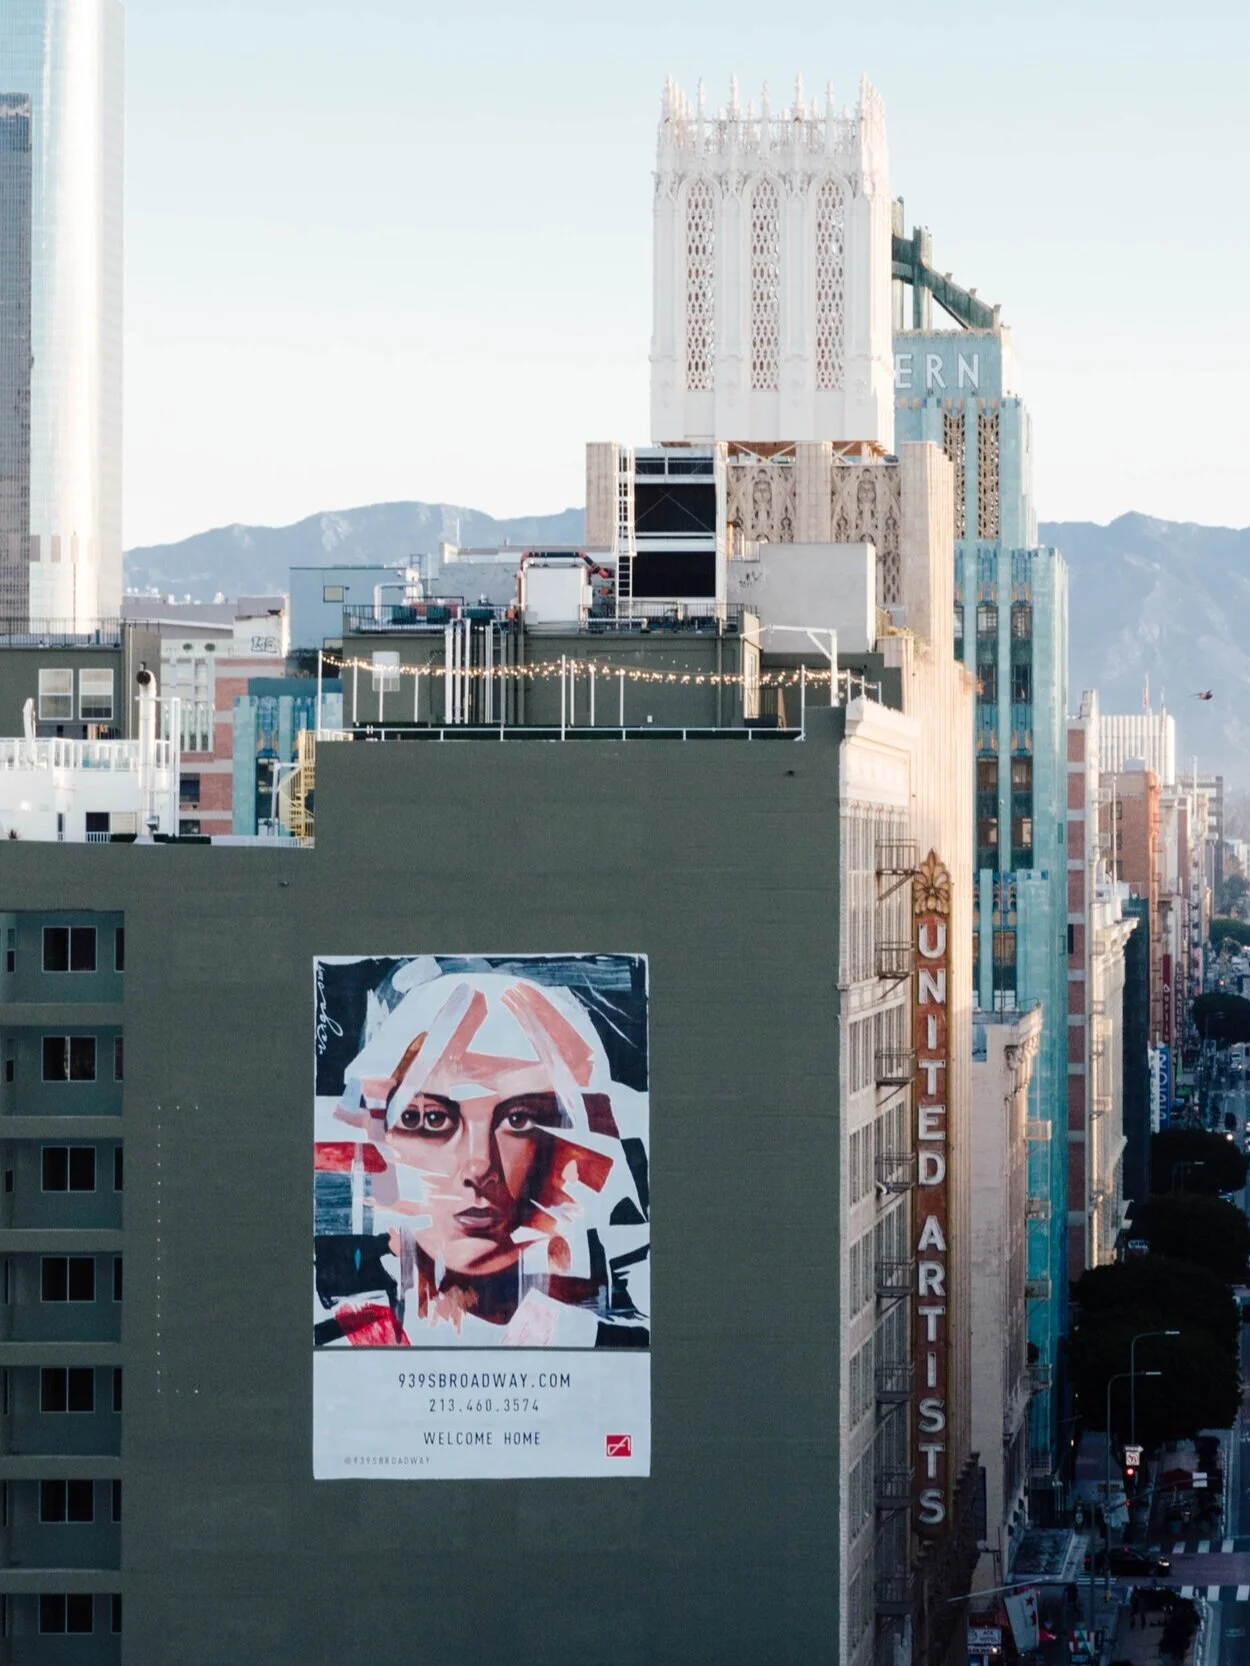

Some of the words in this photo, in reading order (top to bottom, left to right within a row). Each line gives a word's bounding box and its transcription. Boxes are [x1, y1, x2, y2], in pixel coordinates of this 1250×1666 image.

[918, 922, 947, 1186] UNITED
[918, 1215, 947, 1524] ARTISTS
[398, 1373, 571, 1389] 939SBROADWAY.COM
[429, 1399, 539, 1412] 213.460.3574
[424, 1432, 493, 1445] WELCOME
[504, 1432, 541, 1445] HOME
